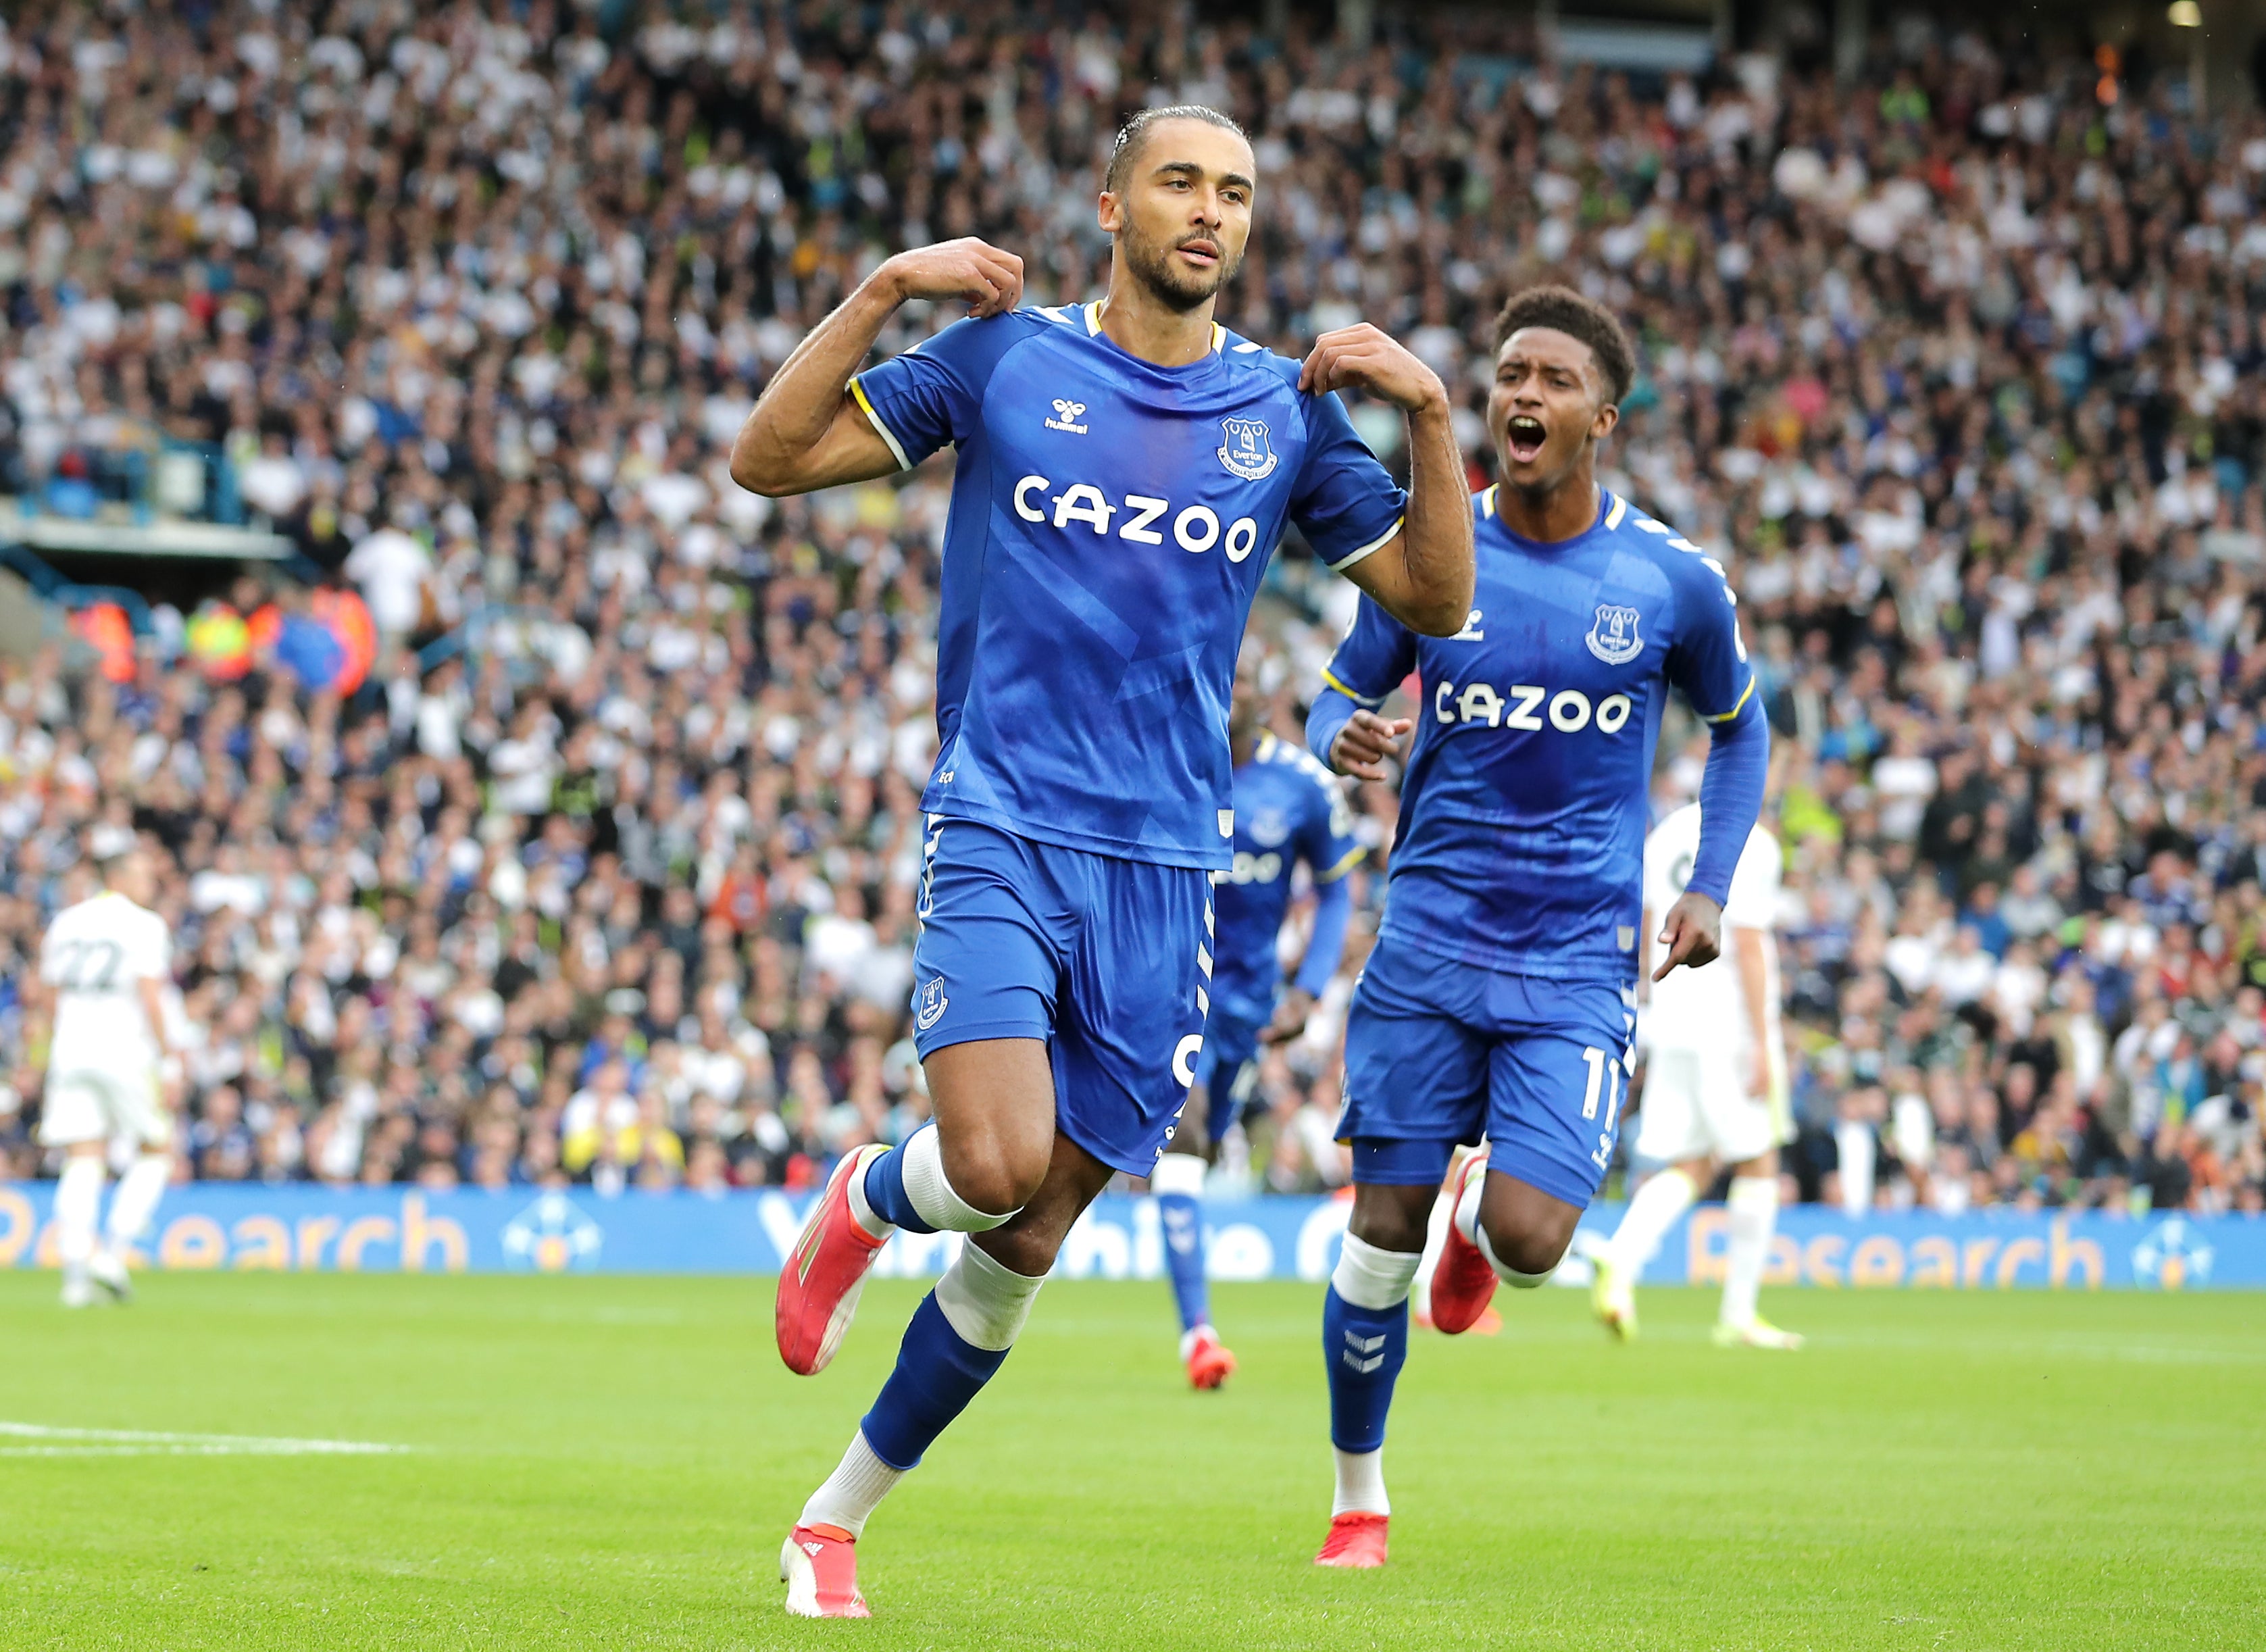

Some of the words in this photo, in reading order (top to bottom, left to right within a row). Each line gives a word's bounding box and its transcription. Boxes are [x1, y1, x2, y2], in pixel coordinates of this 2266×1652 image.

[1044, 417, 1088, 434] hummel
[1233, 449, 1263, 462] Everton
[1013, 474, 1257, 564] CAZOO
[1435, 680, 1632, 734] CAZOO
[54, 936, 127, 995] 22
[1582, 1045, 1620, 1132] 11
[1687, 1207, 2103, 1288] Research
